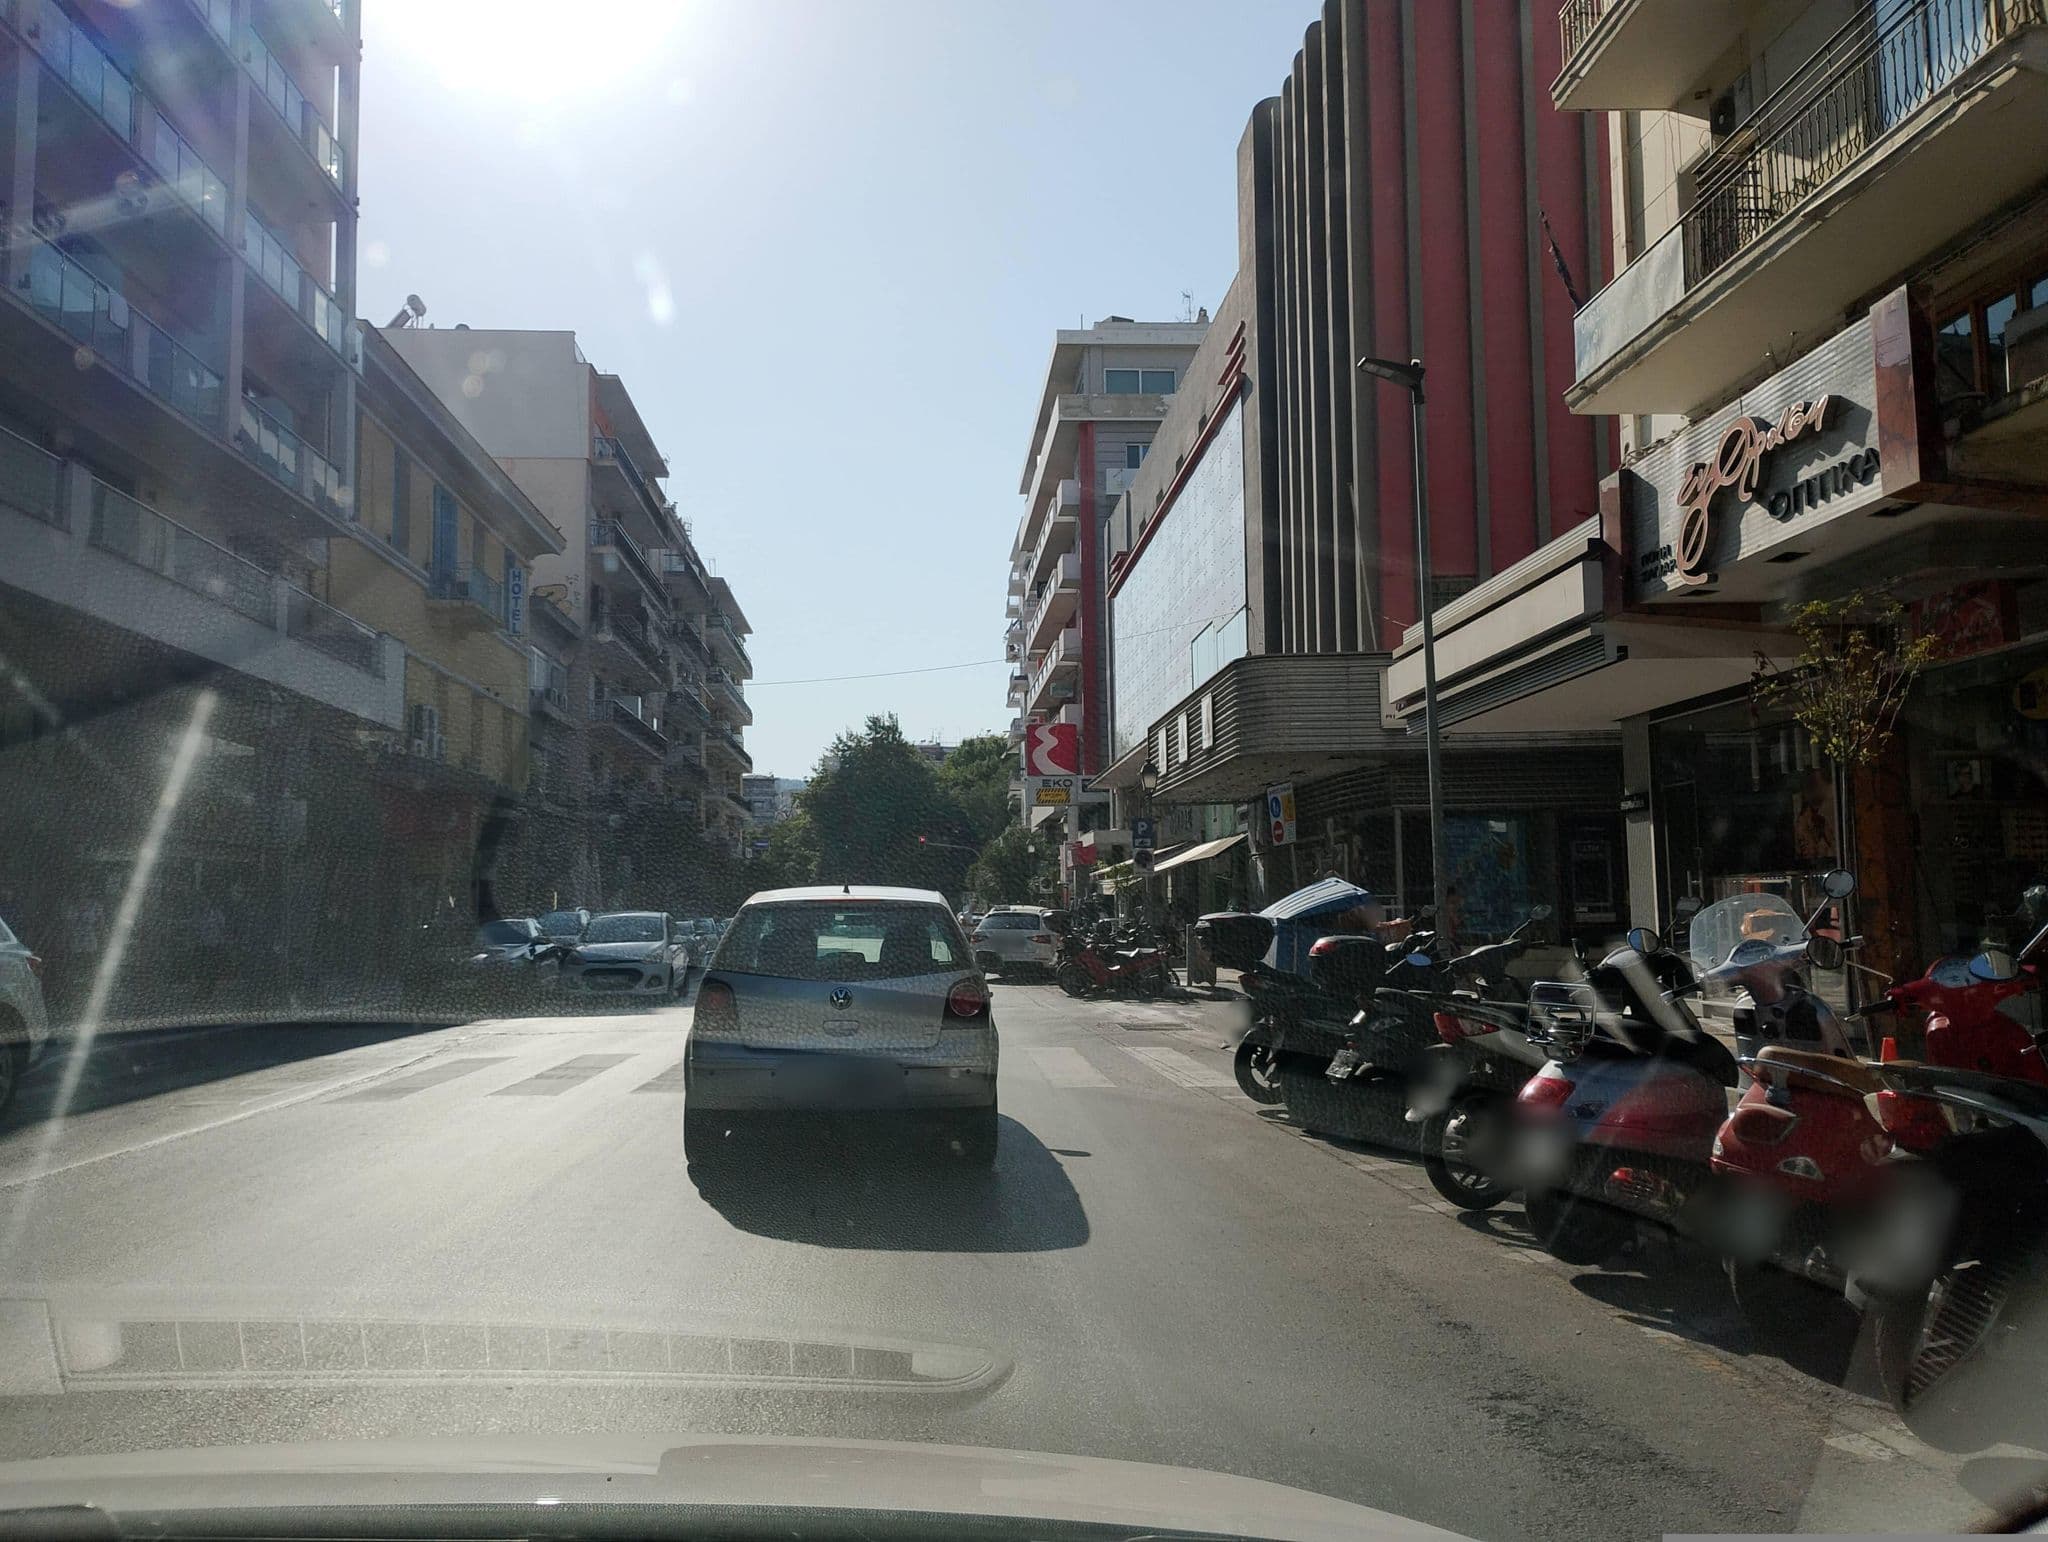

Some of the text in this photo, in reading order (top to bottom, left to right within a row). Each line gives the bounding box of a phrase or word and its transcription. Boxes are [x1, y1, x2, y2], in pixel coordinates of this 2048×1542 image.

[512, 570, 522, 635] HOTEL
[1042, 778, 1073, 788] EKO
[1137, 821, 1148, 835] P
